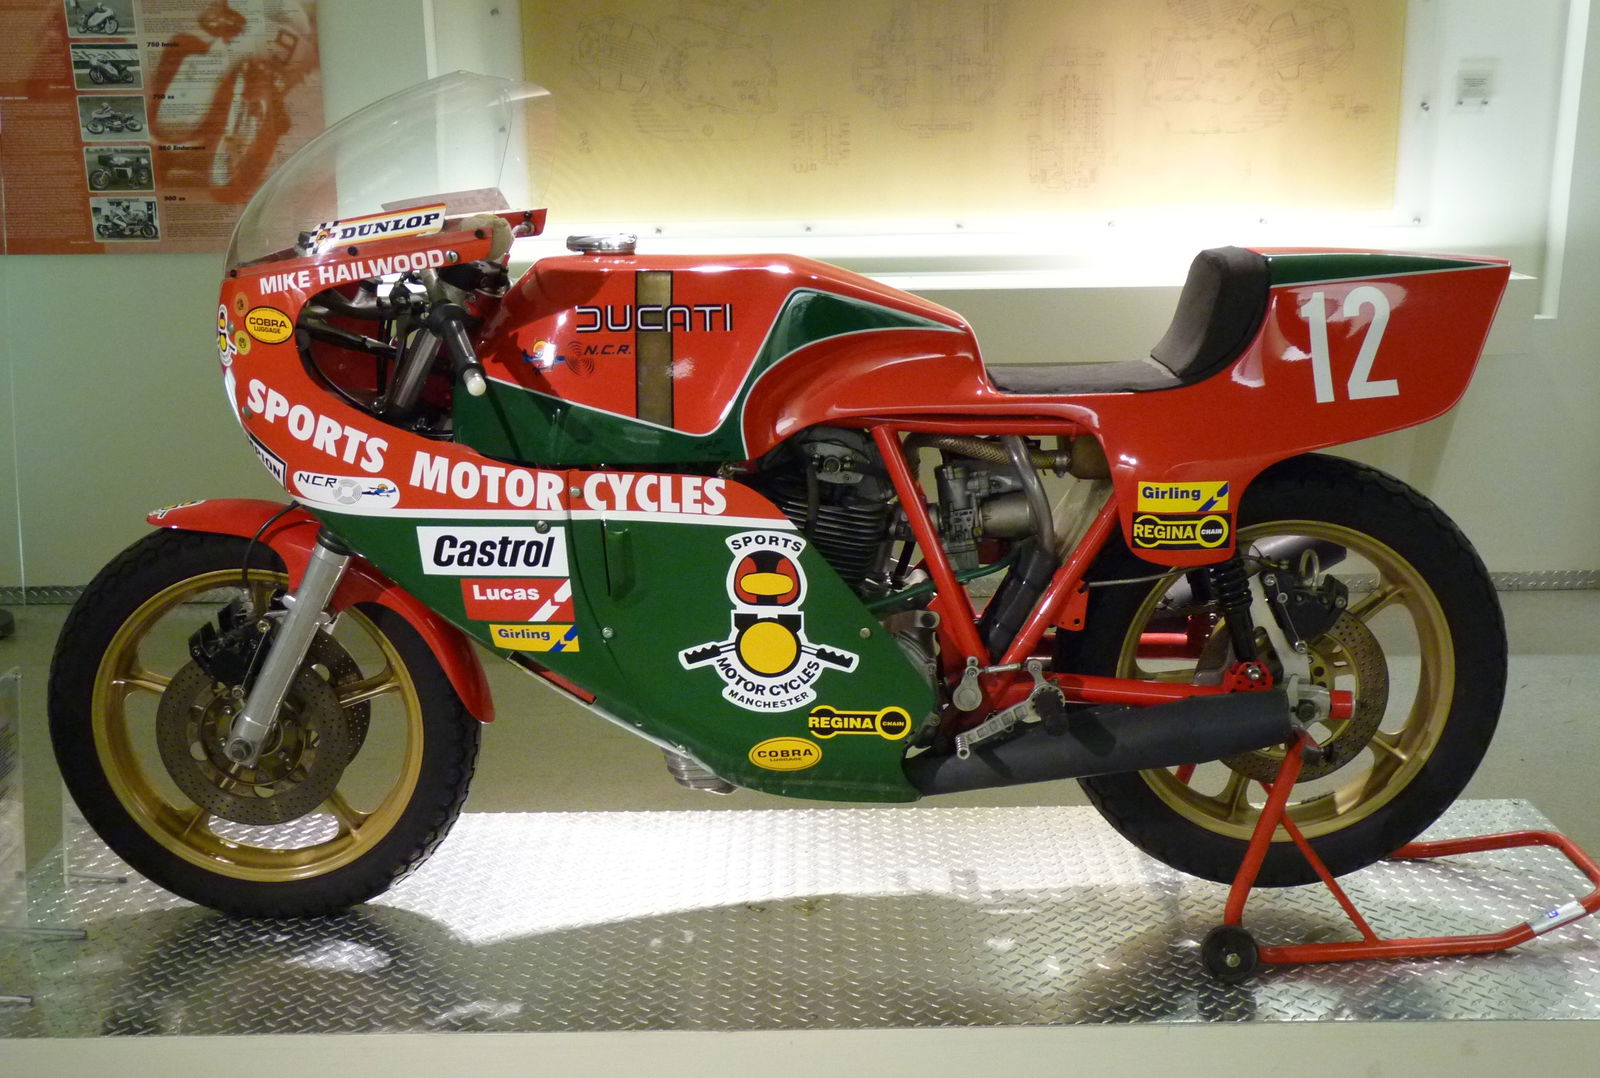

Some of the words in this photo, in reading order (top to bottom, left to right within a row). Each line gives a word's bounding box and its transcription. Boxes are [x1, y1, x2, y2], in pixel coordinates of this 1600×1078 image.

[339, 212, 440, 240] DUNLOP
[259, 270, 312, 296] MIKE
[318, 249, 444, 285] HAILWOOD
[249, 317, 288, 329] COBRA
[575, 303, 733, 333] DUCATI
[254, 326, 281, 334] LUGGAGE
[1299, 285, 1400, 403] 12
[247, 378, 389, 474] SPORTS
[409, 450, 566, 511] MOTOR
[583, 473, 727, 515] CYCLES
[1142, 486, 1201, 501] Girling
[1133, 523, 1194, 540] REGINA
[1201, 528, 1223, 536] CHAIN
[433, 535, 555, 568] Castrol
[731, 534, 803, 553] SPORTS
[472, 584, 540, 601] Lucas
[497, 628, 551, 642] Girling
[716, 656, 766, 696] MOTOR
[769, 660, 820, 696] CYCLES
[728, 689, 809, 709] MANCHESTER
[808, 716, 874, 730] REGINA
[881, 720, 905, 728] CHAIN
[757, 749, 813, 760] COBRA
